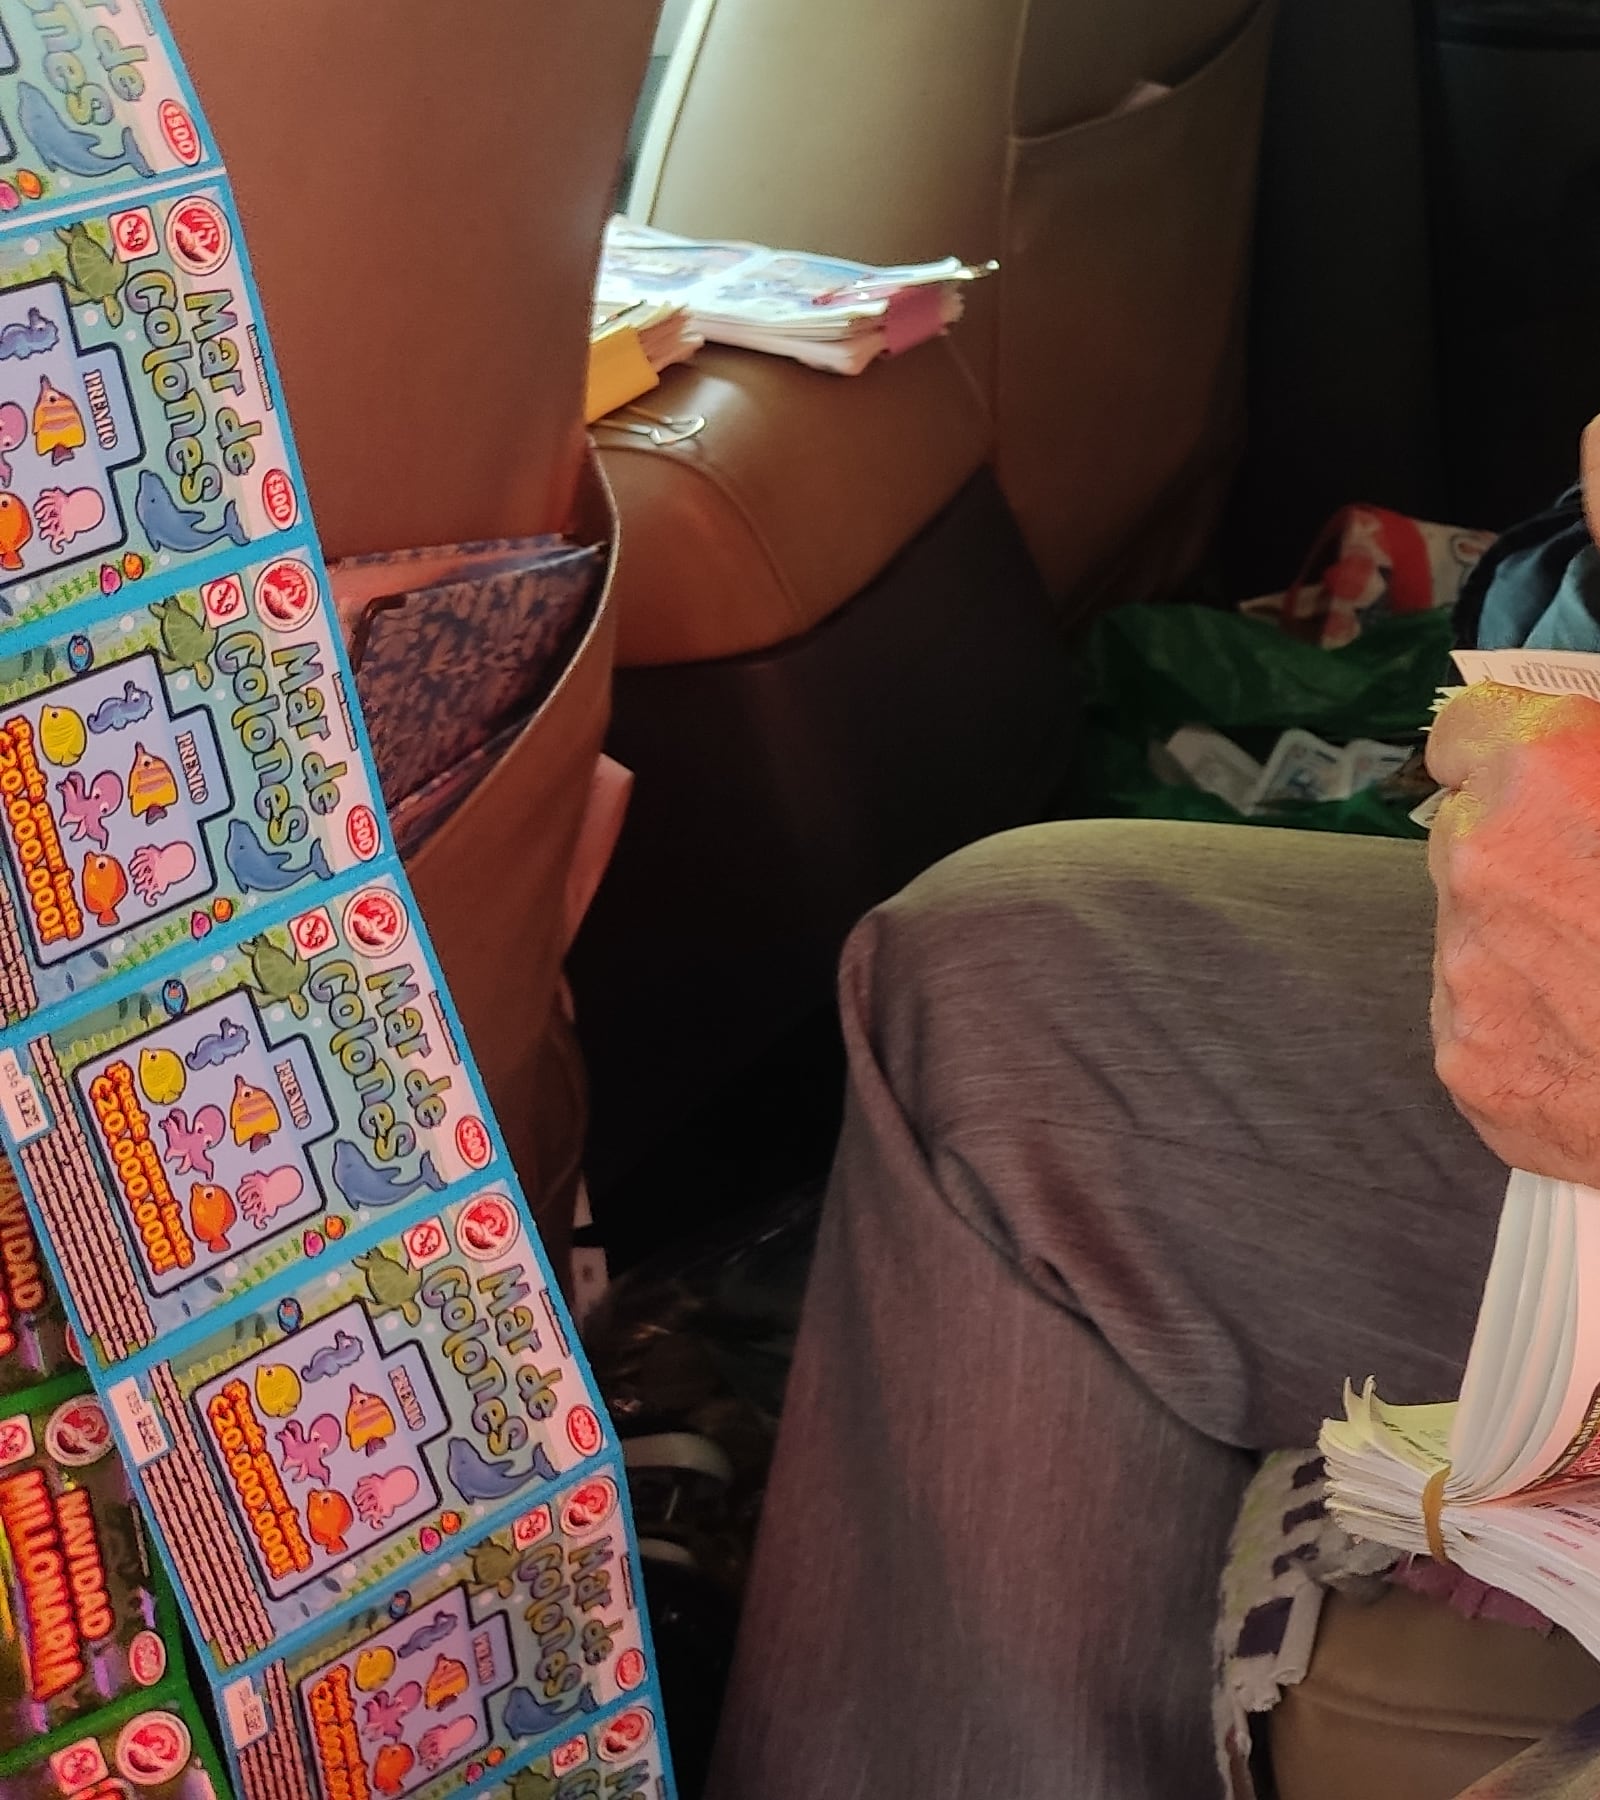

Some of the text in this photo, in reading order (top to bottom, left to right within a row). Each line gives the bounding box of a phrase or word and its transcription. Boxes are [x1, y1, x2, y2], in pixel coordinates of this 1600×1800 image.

[90, 25, 149, 102] de
[83, 368, 119, 450] PREMIO
[124, 270, 223, 504] Colones
[184, 289, 263, 477] Mar de
[174, 731, 209, 805] PREMIO
[216, 631, 309, 846] Colones
[272, 642, 330, 741] Mar
[301, 752, 347, 816] de
[33, 801, 66, 872] ganar
[54, 869, 83, 941] hasta
[274, 1058, 313, 1130] PREMIO
[309, 959, 417, 1161] Colones
[365, 963, 432, 1060] Mar
[404, 1069, 452, 1130] de
[136, 1140, 171, 1206] ganar
[161, 1199, 196, 1269] hasta
[420, 1265, 527, 1457] Colones
[477, 1264, 542, 1353] Mar
[516, 1363, 563, 1419] de
[0, 1467, 85, 1703] MILLONARIA
[56, 1487, 115, 1642] NAVIDAD
[517, 1543, 583, 1698] Colones
[568, 1535, 623, 1667] Mar de
